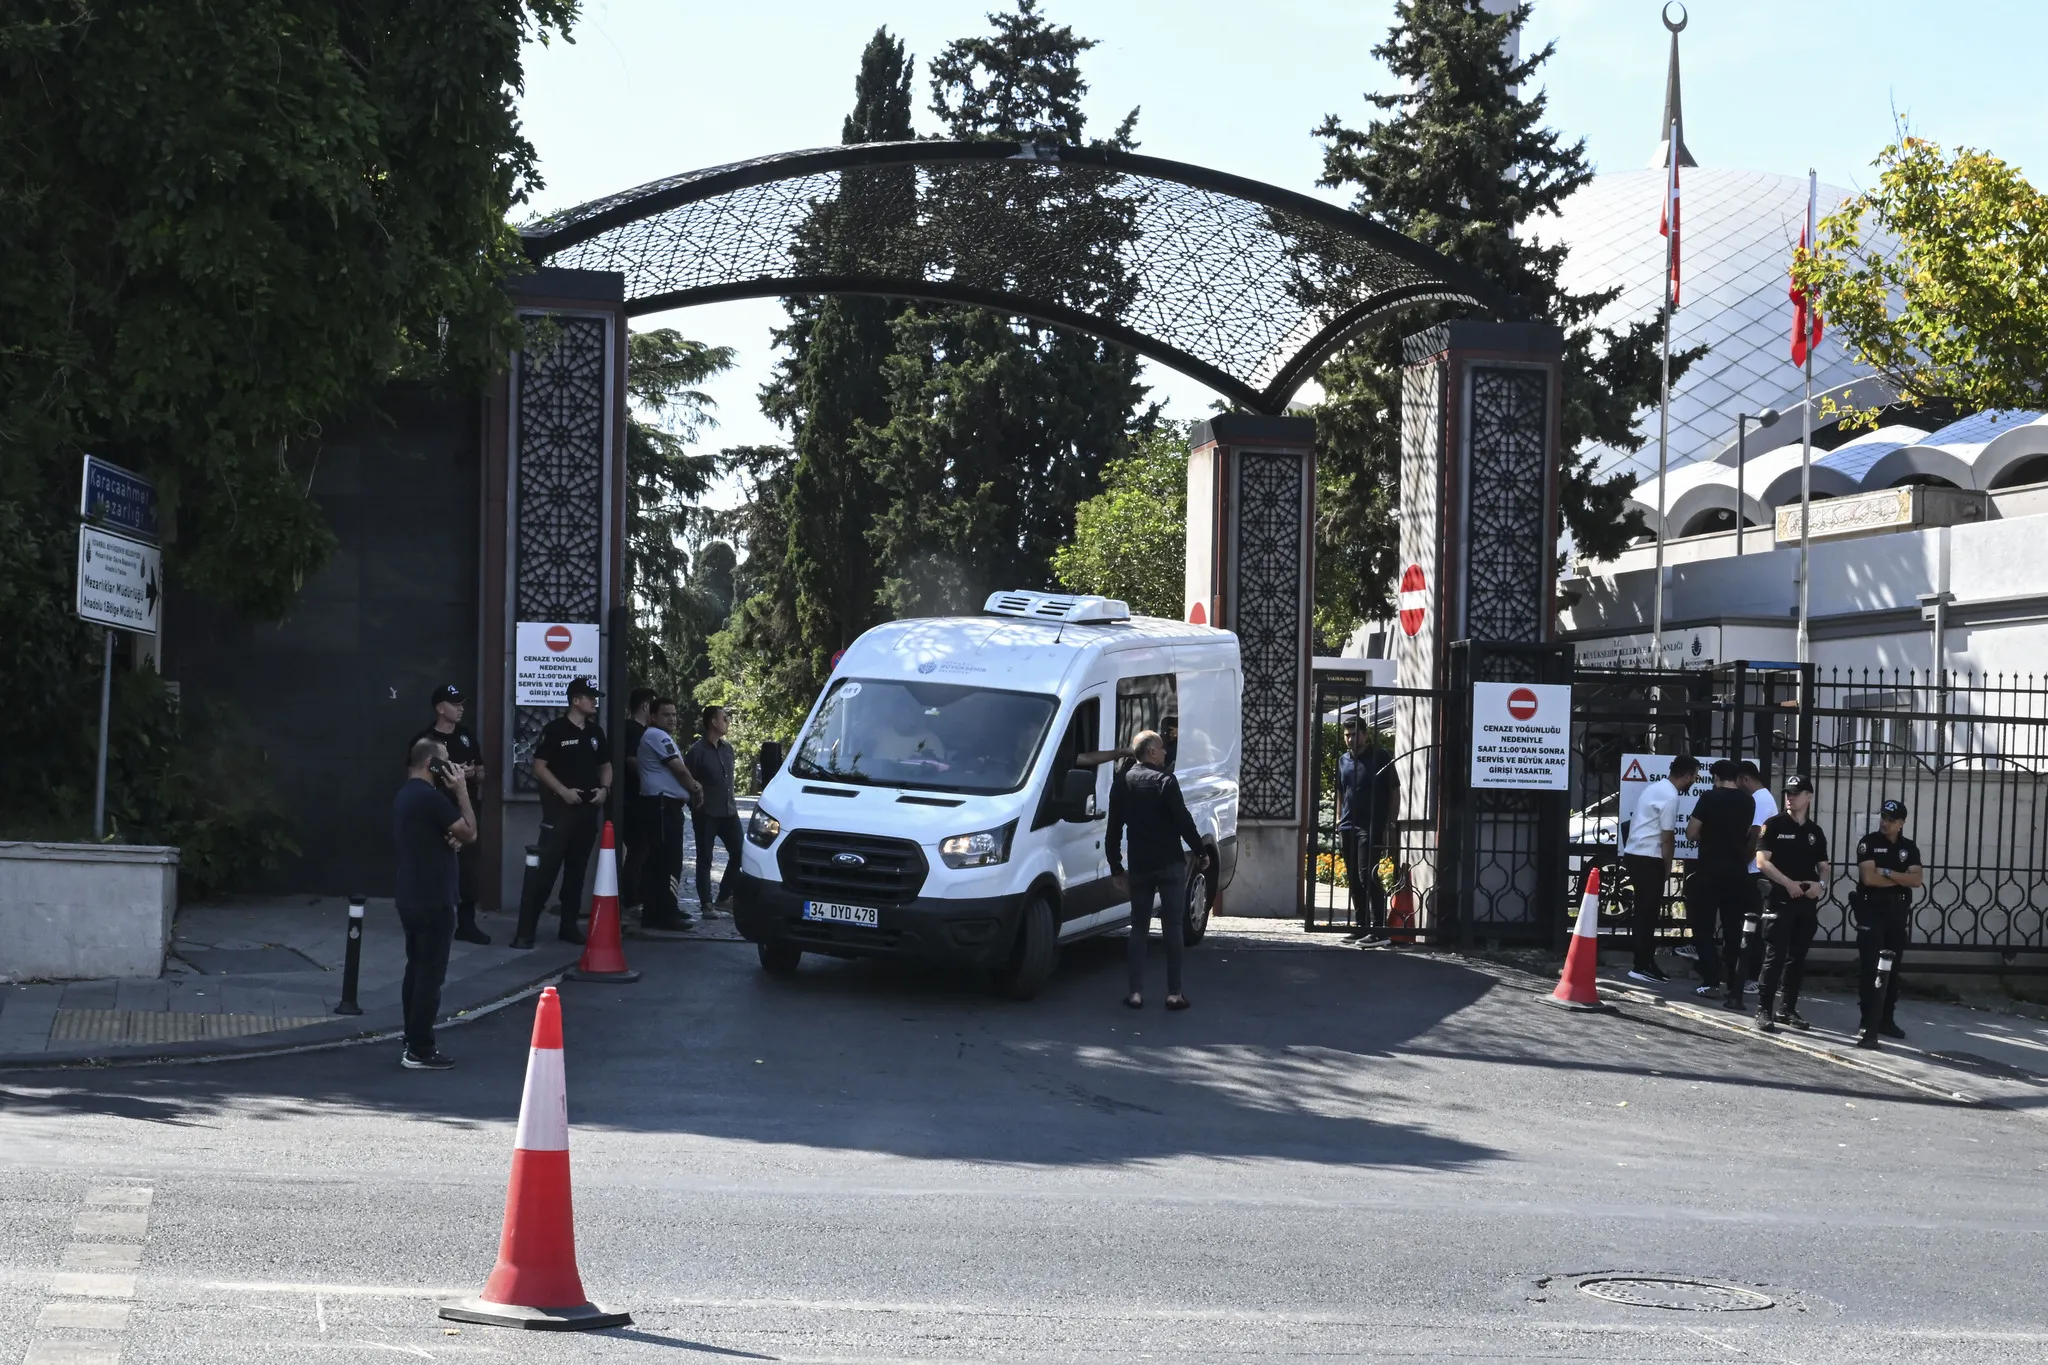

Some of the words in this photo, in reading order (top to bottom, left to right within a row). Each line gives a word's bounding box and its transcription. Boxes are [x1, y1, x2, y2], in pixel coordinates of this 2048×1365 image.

[90, 467, 149, 505] Karacaahmet
[84, 574, 115, 594] Mezarlıklar
[116, 582, 144, 604] Müdürlüğü
[83, 595, 102, 611] Anadolu
[552, 655, 593, 663] YOĞUNLUĞU
[529, 689, 551, 697] GİRİŞİ
[1483, 725, 1513, 733] CENAZE
[1515, 726, 1561, 734] YOĞUNLUĞU
[1500, 735, 1543, 743] NEDENİYLE
[1498, 746, 1537, 754] 11:00'DAN
[1538, 747, 1565, 755] SONRA
[1476, 755, 1504, 763] SERVİS
[1517, 756, 1543, 765] BÜYÜK
[1545, 758, 1566, 767] ARAÇ
[1488, 765, 1513, 775] GİRİŞİ
[1514, 767, 1553, 775] YASAKTIR.
[811, 903, 824, 916] 34
[831, 905, 851, 920] DYD
[855, 908, 876, 922] 478
